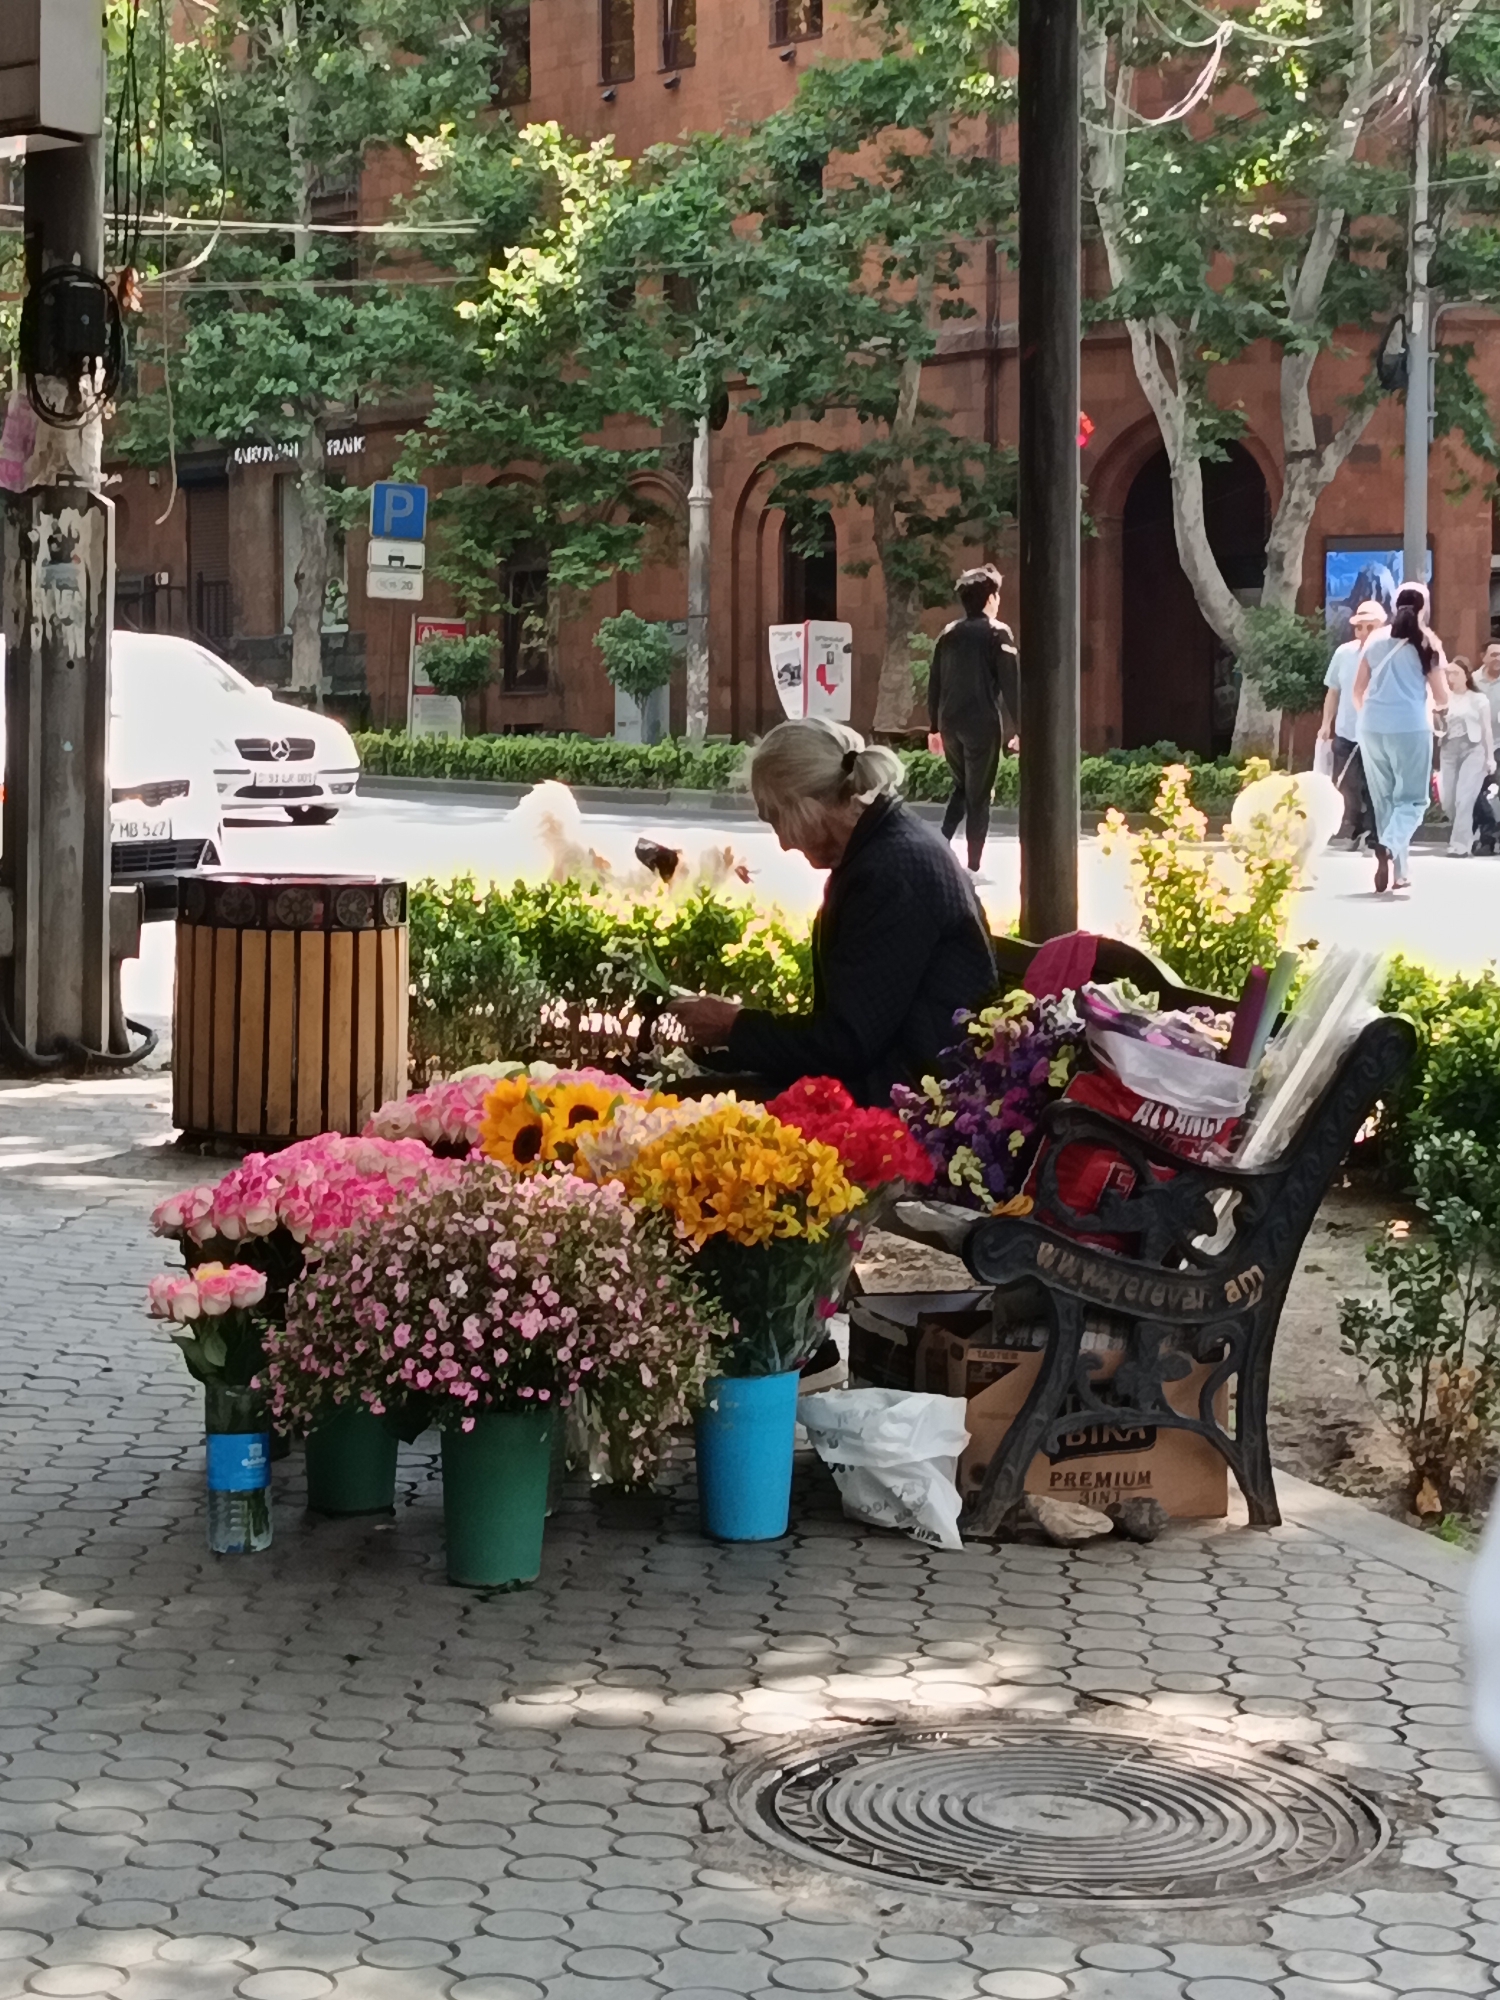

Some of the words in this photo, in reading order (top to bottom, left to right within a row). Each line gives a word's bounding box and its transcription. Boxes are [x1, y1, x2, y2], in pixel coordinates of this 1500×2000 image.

[384, 488, 414, 533] P
[401, 580, 413, 590] 20
[1049, 1470, 1151, 1489] PREMIUM
